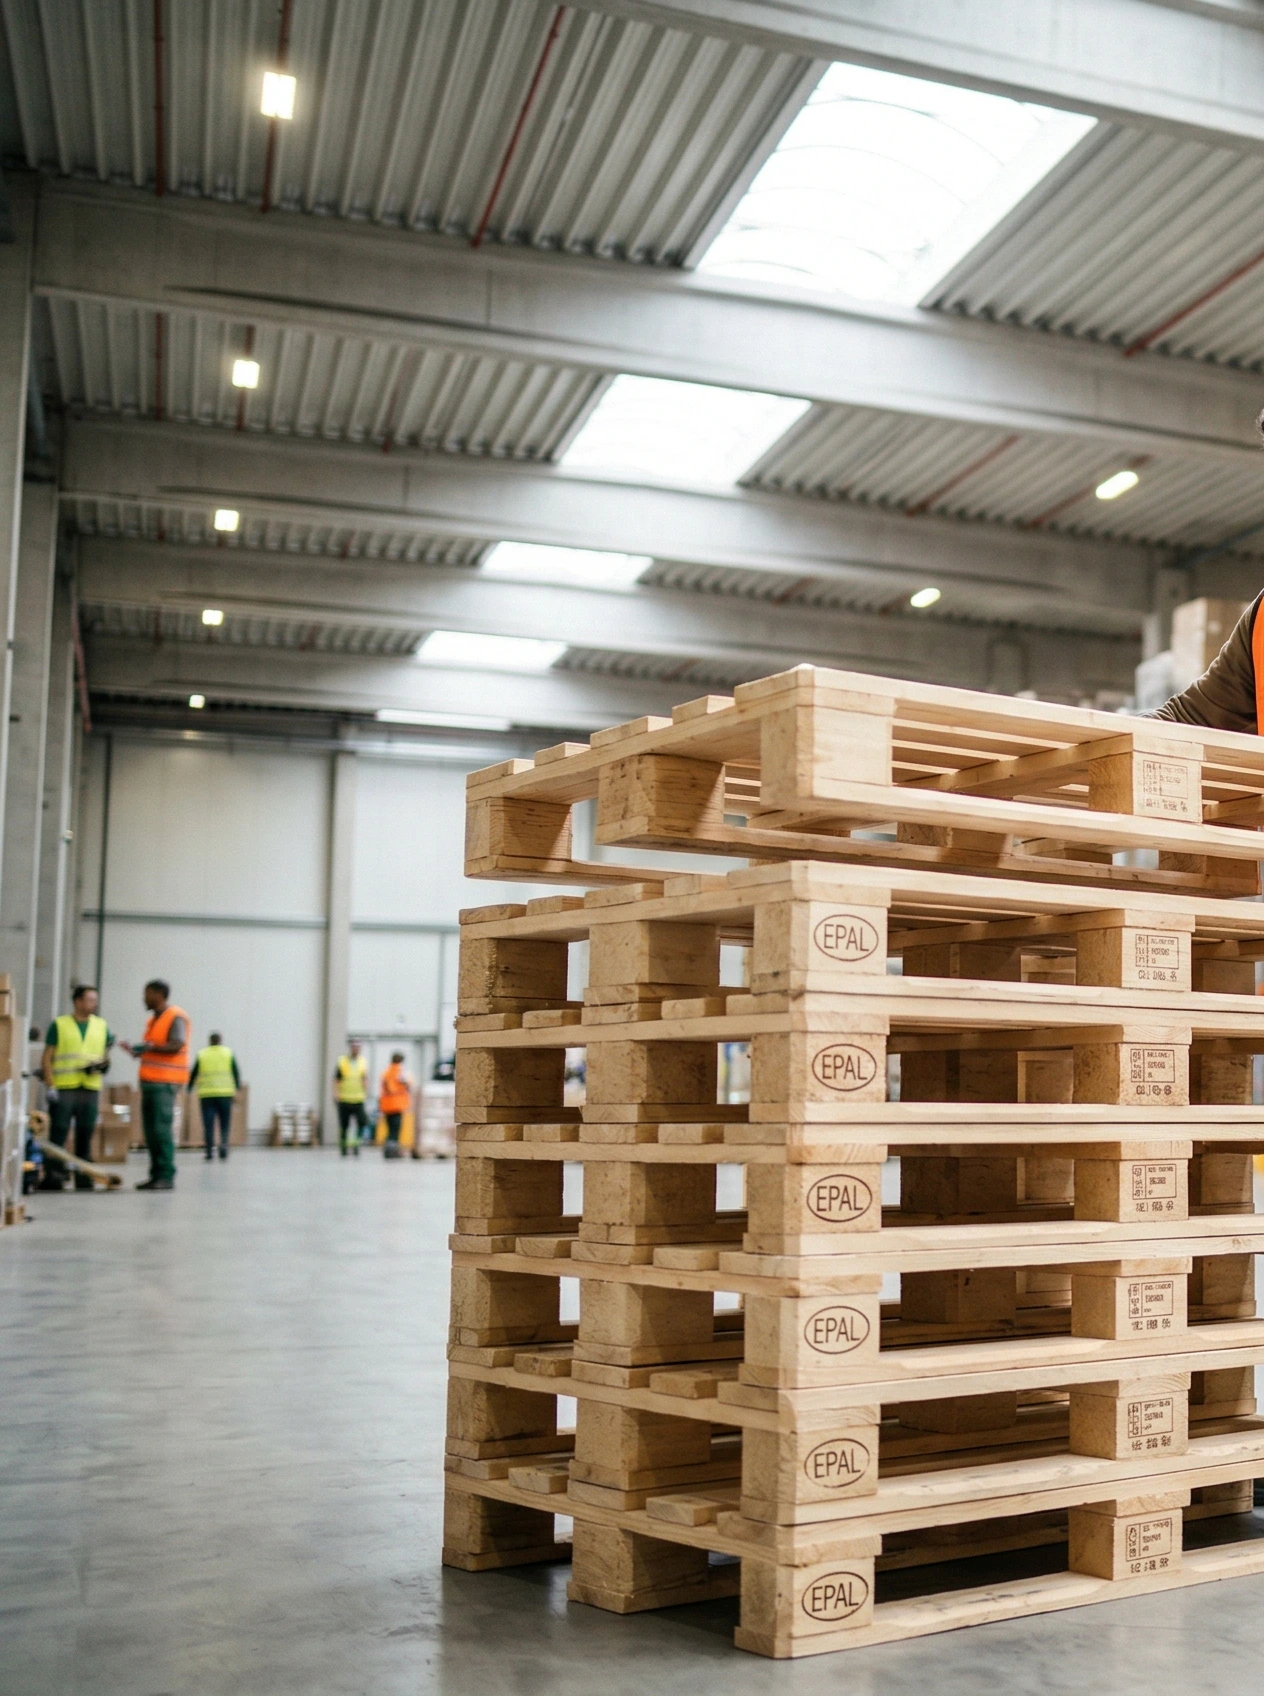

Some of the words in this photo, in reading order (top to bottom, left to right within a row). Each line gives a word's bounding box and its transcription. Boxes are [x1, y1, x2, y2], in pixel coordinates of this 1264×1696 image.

[824, 924, 869, 951] EPAL
[822, 1055, 867, 1080] EPAL
[817, 1185, 863, 1212] EPAL
[814, 1317, 860, 1344] EPAL
[814, 1449, 860, 1478] EPAL
[812, 1583, 858, 1612] EPAL
